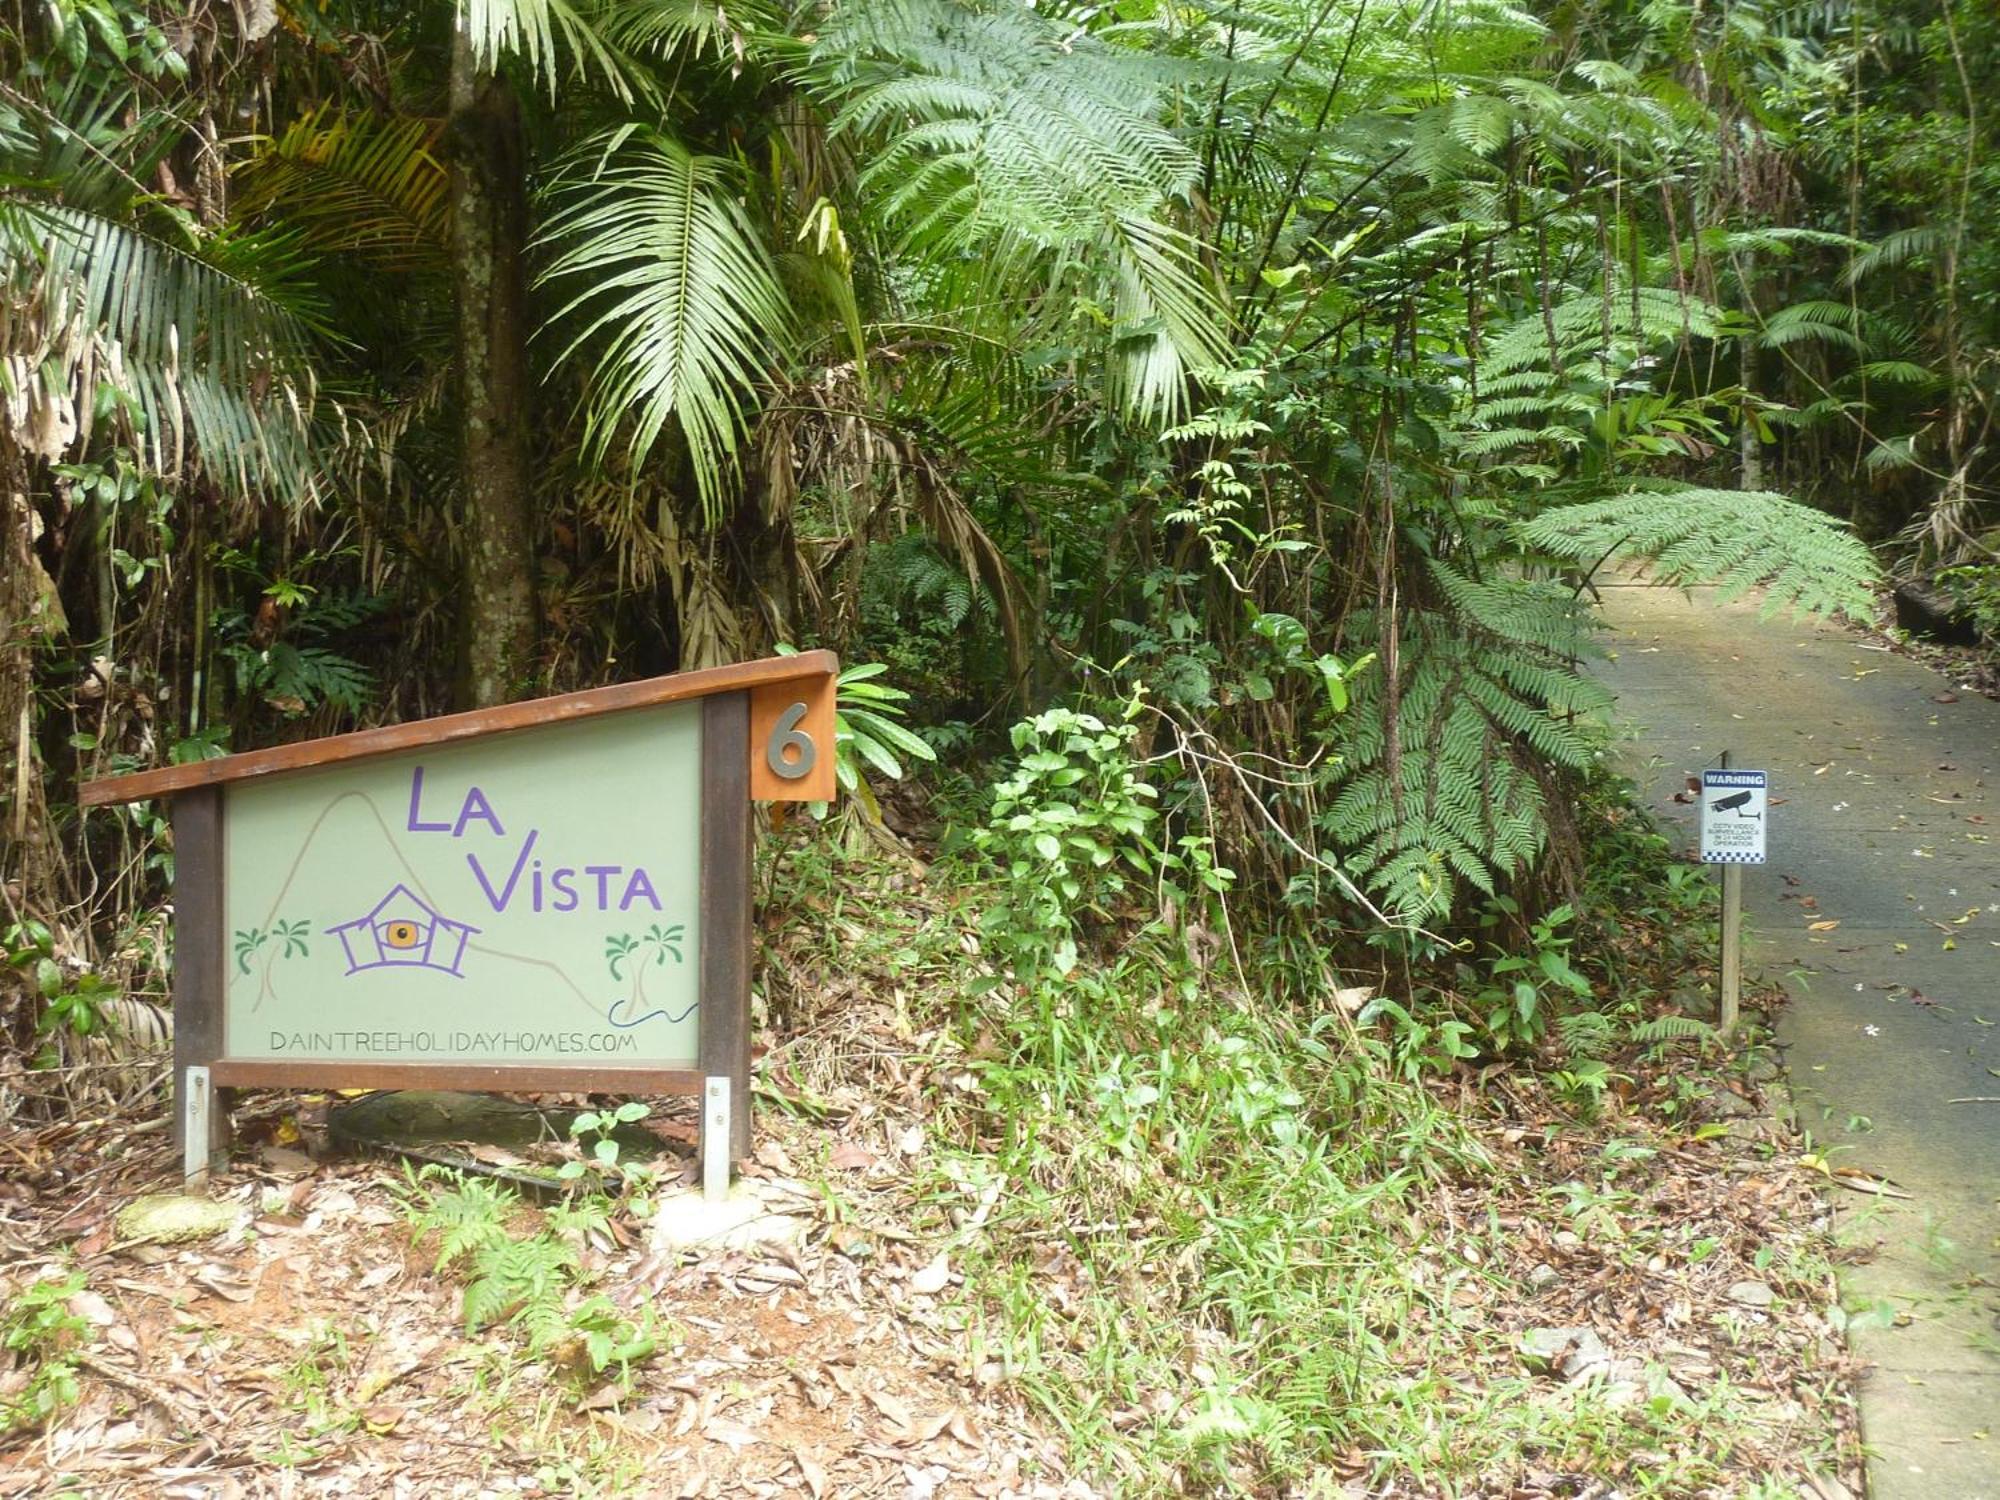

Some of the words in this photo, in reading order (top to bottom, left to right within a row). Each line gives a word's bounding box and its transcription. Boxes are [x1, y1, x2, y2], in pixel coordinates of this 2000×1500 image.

[768, 702, 817, 779] 6
[408, 766, 505, 837] LA
[1706, 775, 1764, 784] WARNING
[269, 1031, 638, 1053] DAINTREEHOLIDAYHOMES.COM
